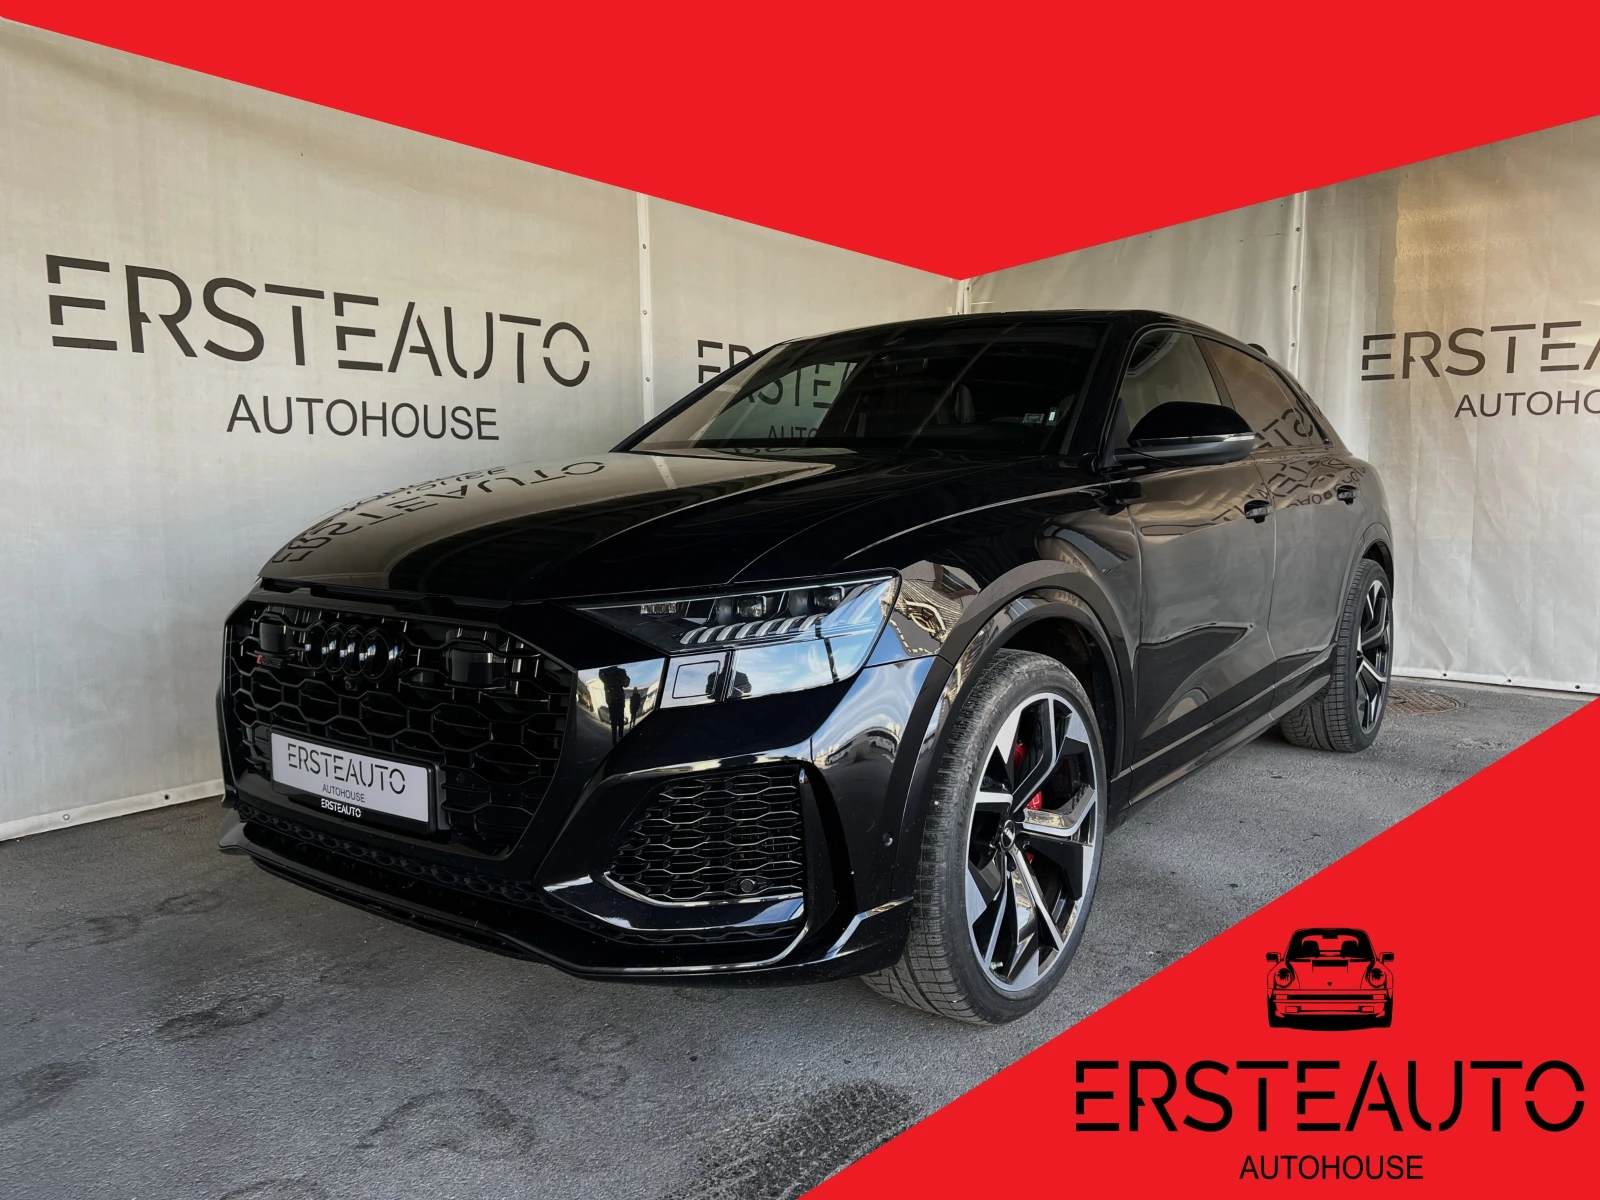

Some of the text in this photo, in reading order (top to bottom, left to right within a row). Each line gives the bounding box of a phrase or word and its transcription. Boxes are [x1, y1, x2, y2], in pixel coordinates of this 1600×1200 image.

[46, 255, 590, 387] ERSTEAUTO
[227, 394, 499, 440] AUTOHOUSE
[288, 743, 406, 795] ERSTEAUTO
[321, 798, 362, 819] ERSTEAUTO
[322, 784, 366, 804] AUTOHOUSE
